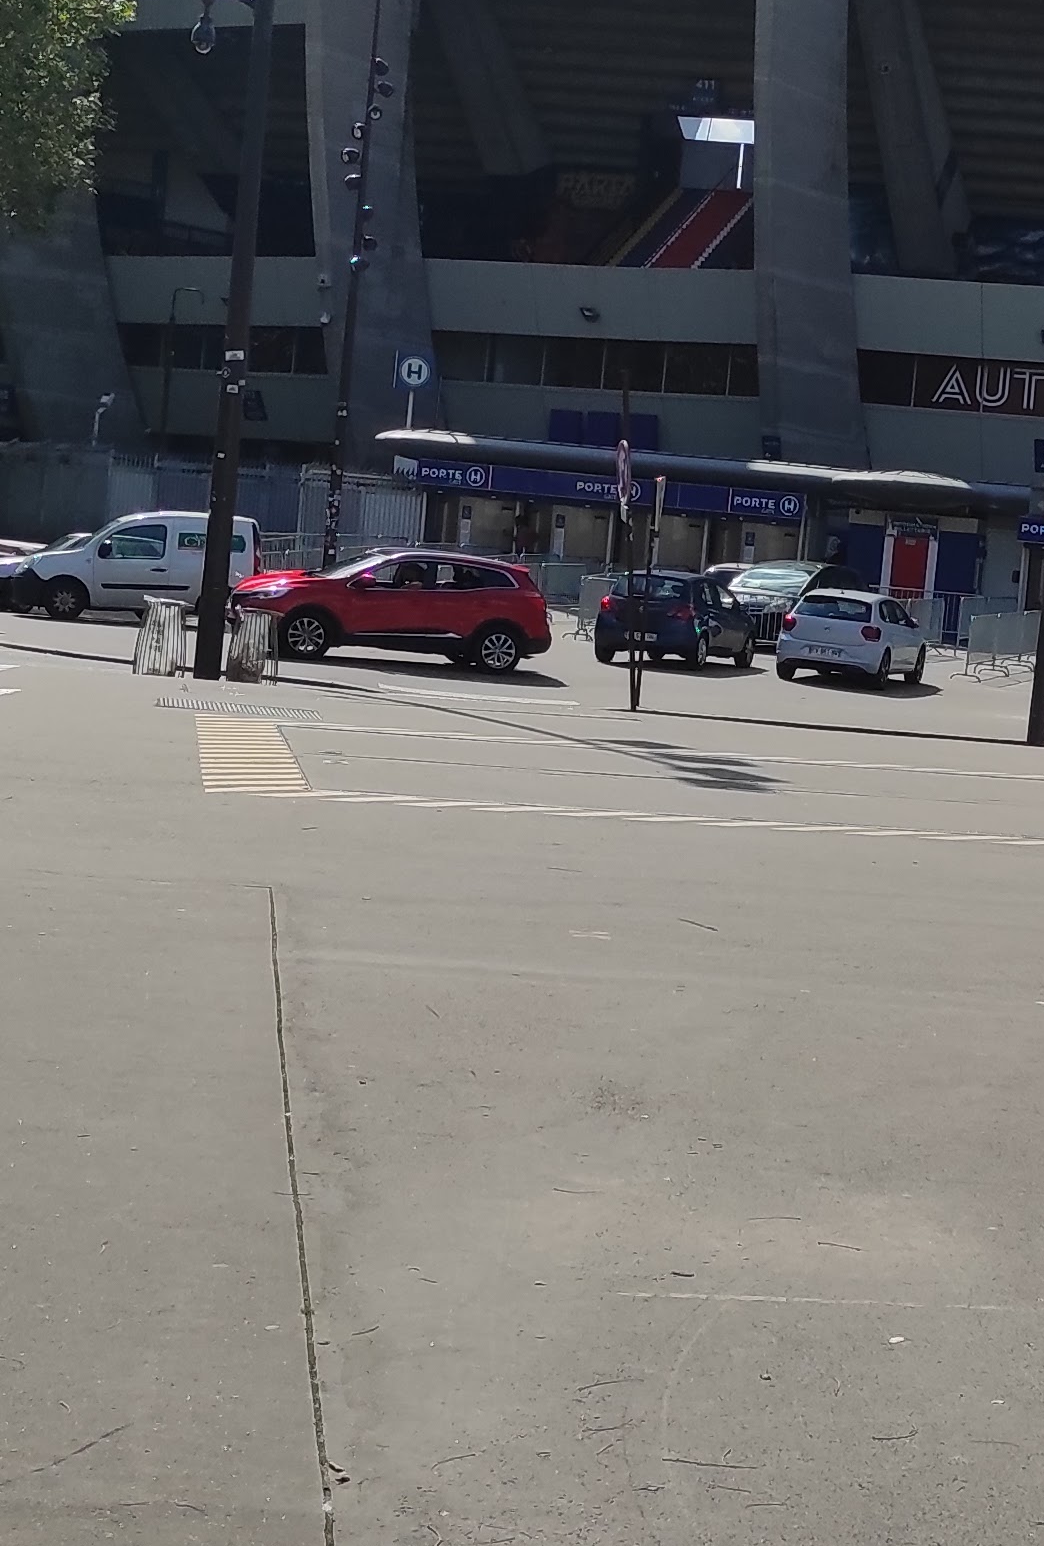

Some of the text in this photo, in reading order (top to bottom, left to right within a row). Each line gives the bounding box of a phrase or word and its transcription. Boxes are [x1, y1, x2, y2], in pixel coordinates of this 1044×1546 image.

[407, 362, 422, 380] H
[421, 467, 463, 480] PORTE
[576, 481, 618, 494] PORTE
[733, 495, 795, 511] PORTE H
